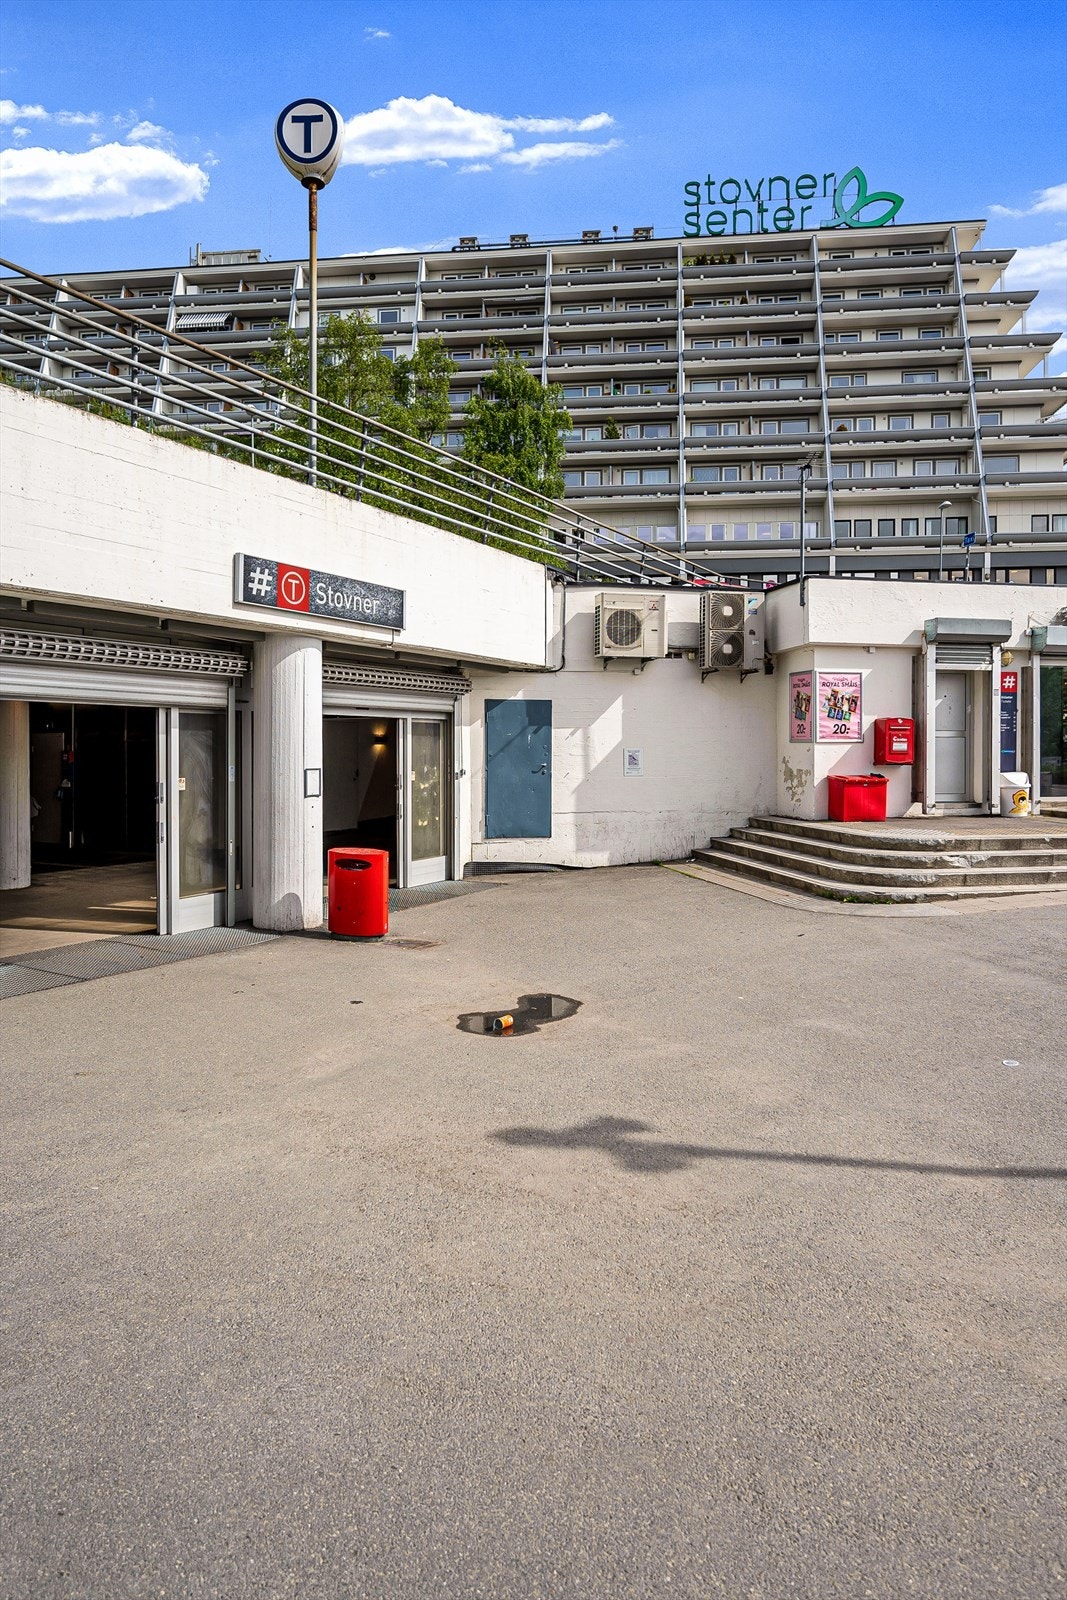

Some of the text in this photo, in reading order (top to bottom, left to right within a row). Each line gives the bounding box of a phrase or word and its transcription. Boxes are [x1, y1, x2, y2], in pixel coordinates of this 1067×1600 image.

[291, 114, 323, 153] T
[684, 172, 835, 206] stovner
[683, 200, 812, 237] senter
[315, 582, 381, 615] Stovner
